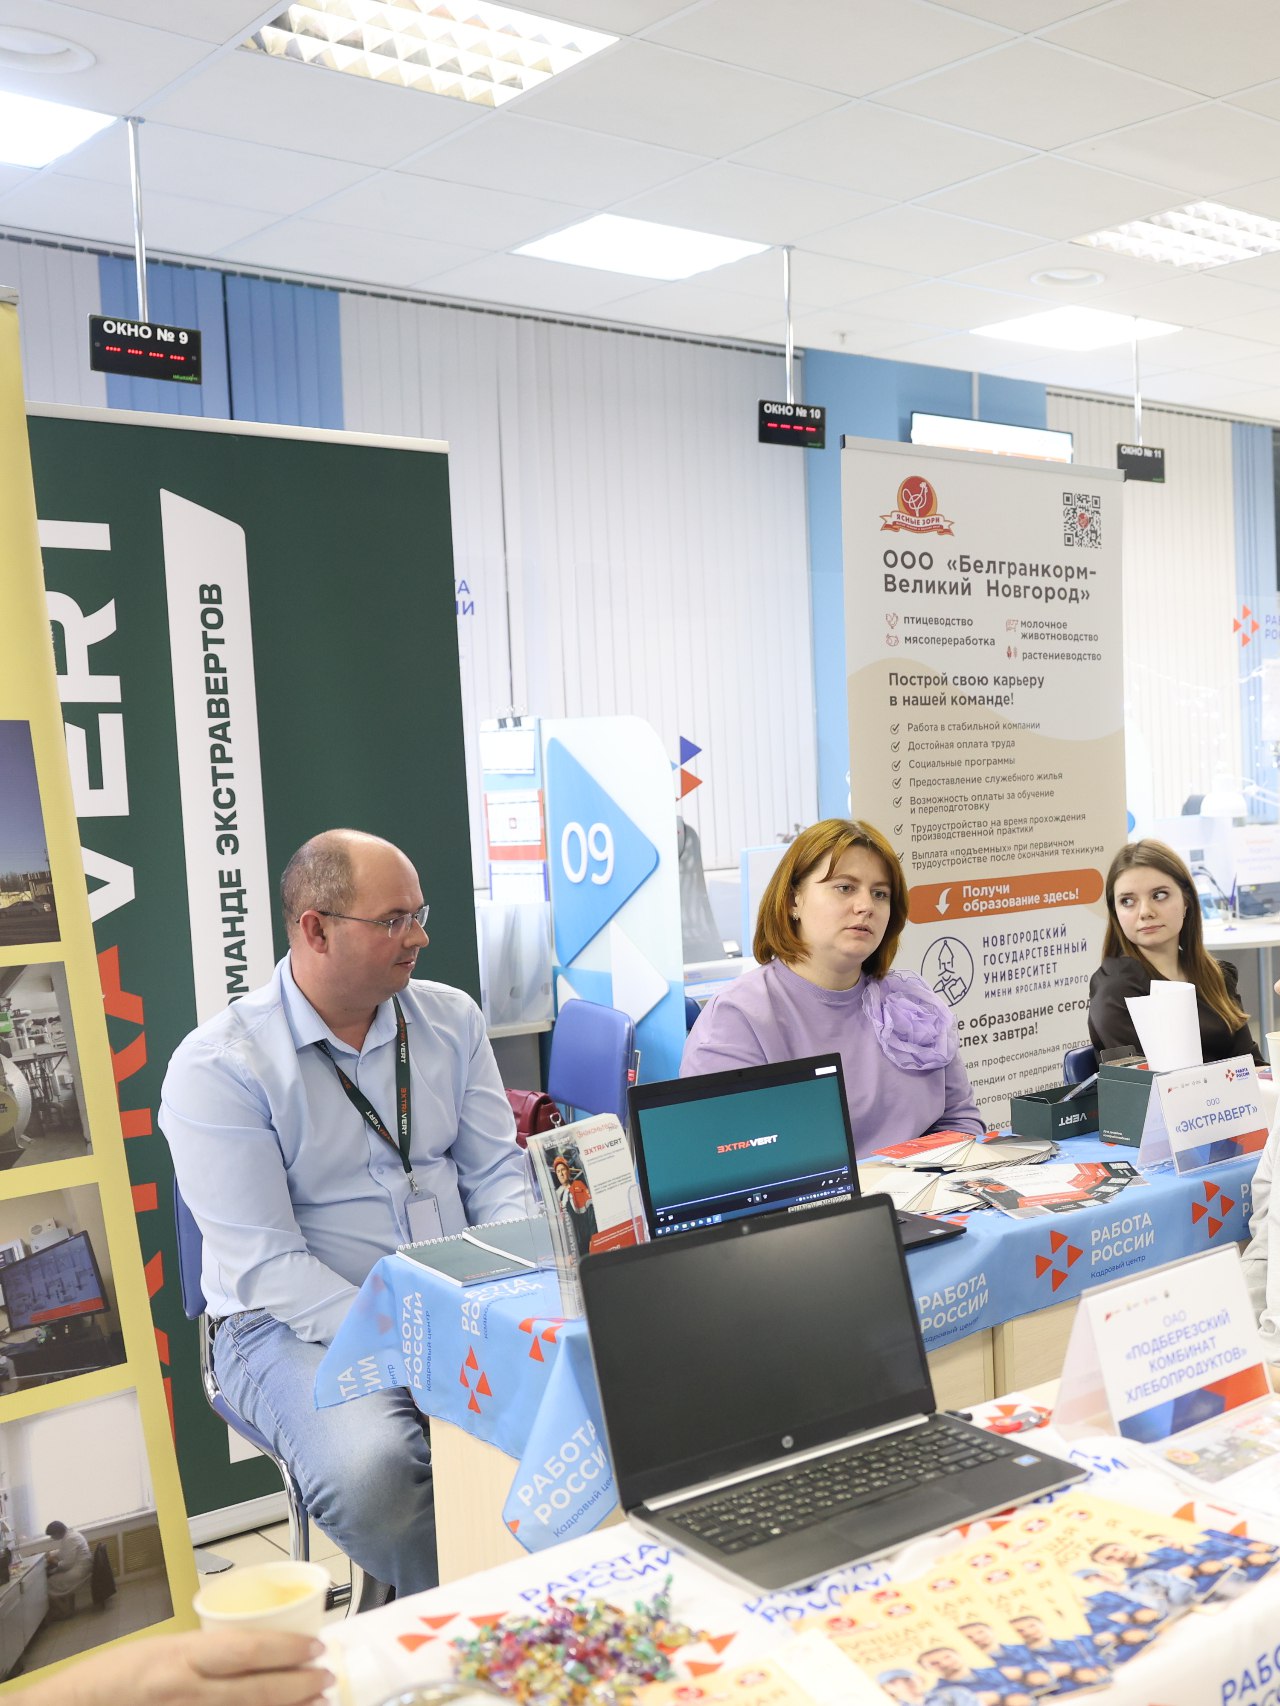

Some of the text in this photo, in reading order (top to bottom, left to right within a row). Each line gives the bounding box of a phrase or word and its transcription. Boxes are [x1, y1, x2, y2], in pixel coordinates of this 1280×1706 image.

[103, 320, 188, 345] ОКНО № 9
[764, 403, 821, 419] ОКНО № 10
[1121, 445, 1143, 456] ОКНО
[1154, 449, 1161, 458] 11
[896, 513, 940, 525] ЯСНЫЕ ЗОРИ
[883, 549, 1097, 583] ООО «Белгранкорм-
[884, 574, 1090, 603] Великий Новгород»
[903, 615, 973, 627] птицеводство
[1020, 620, 1067, 629] молочное
[904, 635, 995, 647] мясопереработка
[1021, 632, 1099, 642] животноводство
[1022, 652, 1102, 662] растениеводство
[889, 672, 1044, 688] Построй свою карьеру
[889, 692, 1014, 707] в нашей команде!
[907, 722, 938, 732] Работа
[947, 721, 1000, 731] стабильной
[1002, 722, 1041, 730] компании
[908, 740, 1016, 751] Достойная оплата труда
[908, 757, 1016, 770] Социальные программы
[909, 772, 1063, 788] Предоставление служебного жилья
[199, 583, 248, 1005] МАНДЕ ЭКСТРАВЕРТОВ
[910, 794, 968, 806] Возможность
[971, 793, 1004, 803] оплаты
[1017, 789, 1055, 800] обучение
[910, 803, 990, 815] и переподготовку
[911, 813, 1086, 834] Трудоустройство на время прохождения
[911, 825, 1033, 843] производственной практики
[561, 822, 614, 885] 09
[912, 839, 1074, 861] Выплата «подъемных» при первичном
[912, 845, 1104, 870] трудоустройстве после окончания техникума
[963, 884, 1010, 900] Получи
[963, 888, 1079, 912] образование здесь!
[983, 923, 1067, 948] НОВГОРОДСКИЙ
[983, 939, 1087, 966] ГОСУДАРСТВЕННЫЙ
[984, 962, 1058, 984] УНИВЕРСИТЕТ
[984, 974, 1089, 999] ИМЕНИ ЯРОСЛАВА МУДРОГО
[970, 1005, 1053, 1028] образование
[959, 1022, 1038, 1048] спех завтра!
[982, 1045, 1060, 1067] профессиональная
[1007, 1073, 1017, 1081] от
[975, 1090, 1023, 1106] договоров
[1025, 1086, 1033, 1094] на
[1206, 1098, 1221, 1107] ООО
[1175, 1104, 1258, 1133] «ЭКСТРАВЕРТ»
[1091, 1212, 1152, 1246] РАБОТА
[1091, 1229, 1155, 1266] РОССИИ
[1090, 1255, 1146, 1279] Кадровый центр
[918, 1272, 987, 1314] РАБОТА
[921, 1289, 989, 1334] РОССИИ
[1162, 1309, 1187, 1328] ОАО
[413, 1291, 423, 1390] РОССИИ
[923, 1317, 979, 1344] адровый центр
[1126, 1308, 1231, 1360] «ПОДБЕРЕЗСКИЙ
[1148, 1336, 1216, 1373] КОМБИНАТ
[387, 1364, 398, 1386] ентр
[1125, 1346, 1247, 1404] ХЛЕБОПРОДУКТОВ»
[517, 1419, 596, 1506] РАБОТА
[553, 1489, 602, 1537] Кадровый
[520, 1544, 658, 1601] РАБОТА
